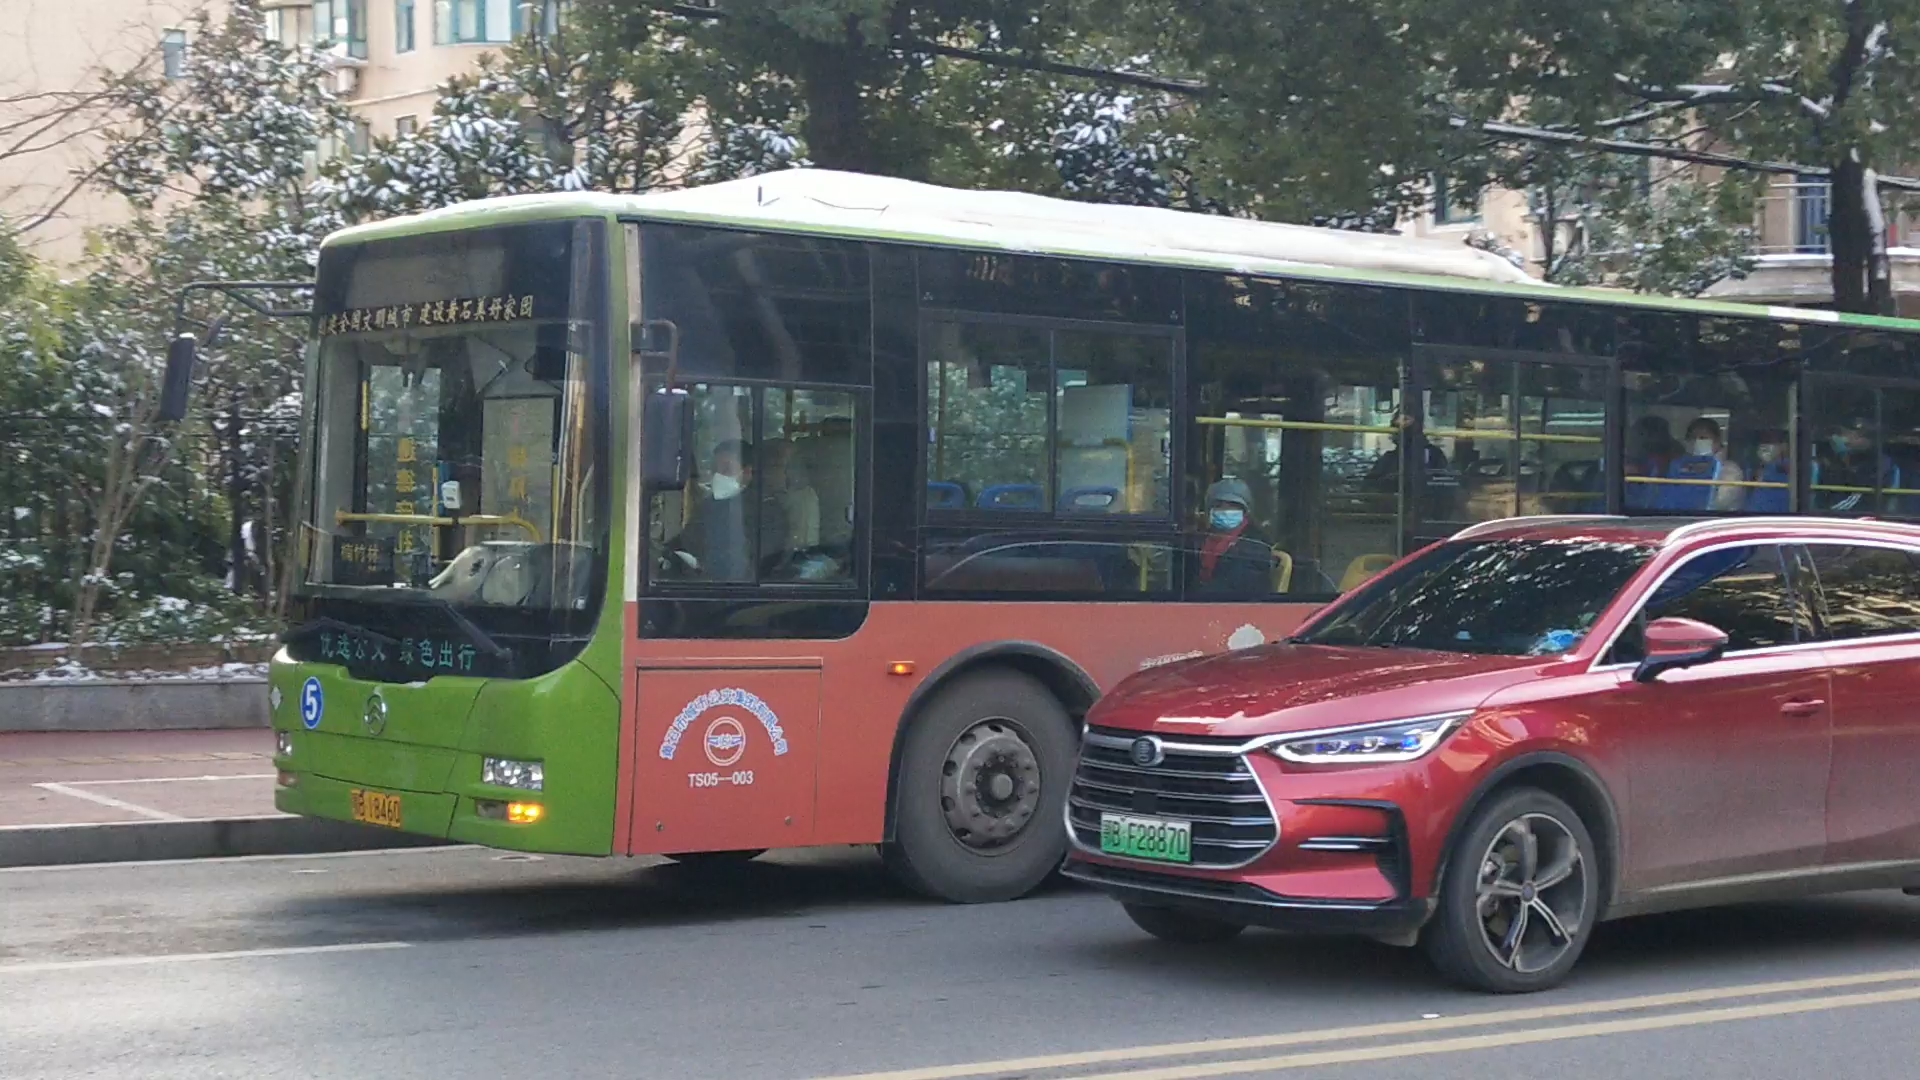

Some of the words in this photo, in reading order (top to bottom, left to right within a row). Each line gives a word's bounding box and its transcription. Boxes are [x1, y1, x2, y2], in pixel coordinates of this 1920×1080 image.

[419, 294, 534, 325] 建设黄石美好家园
[400, 637, 476, 670] 绿色出行
[306, 684, 317, 721] 5
